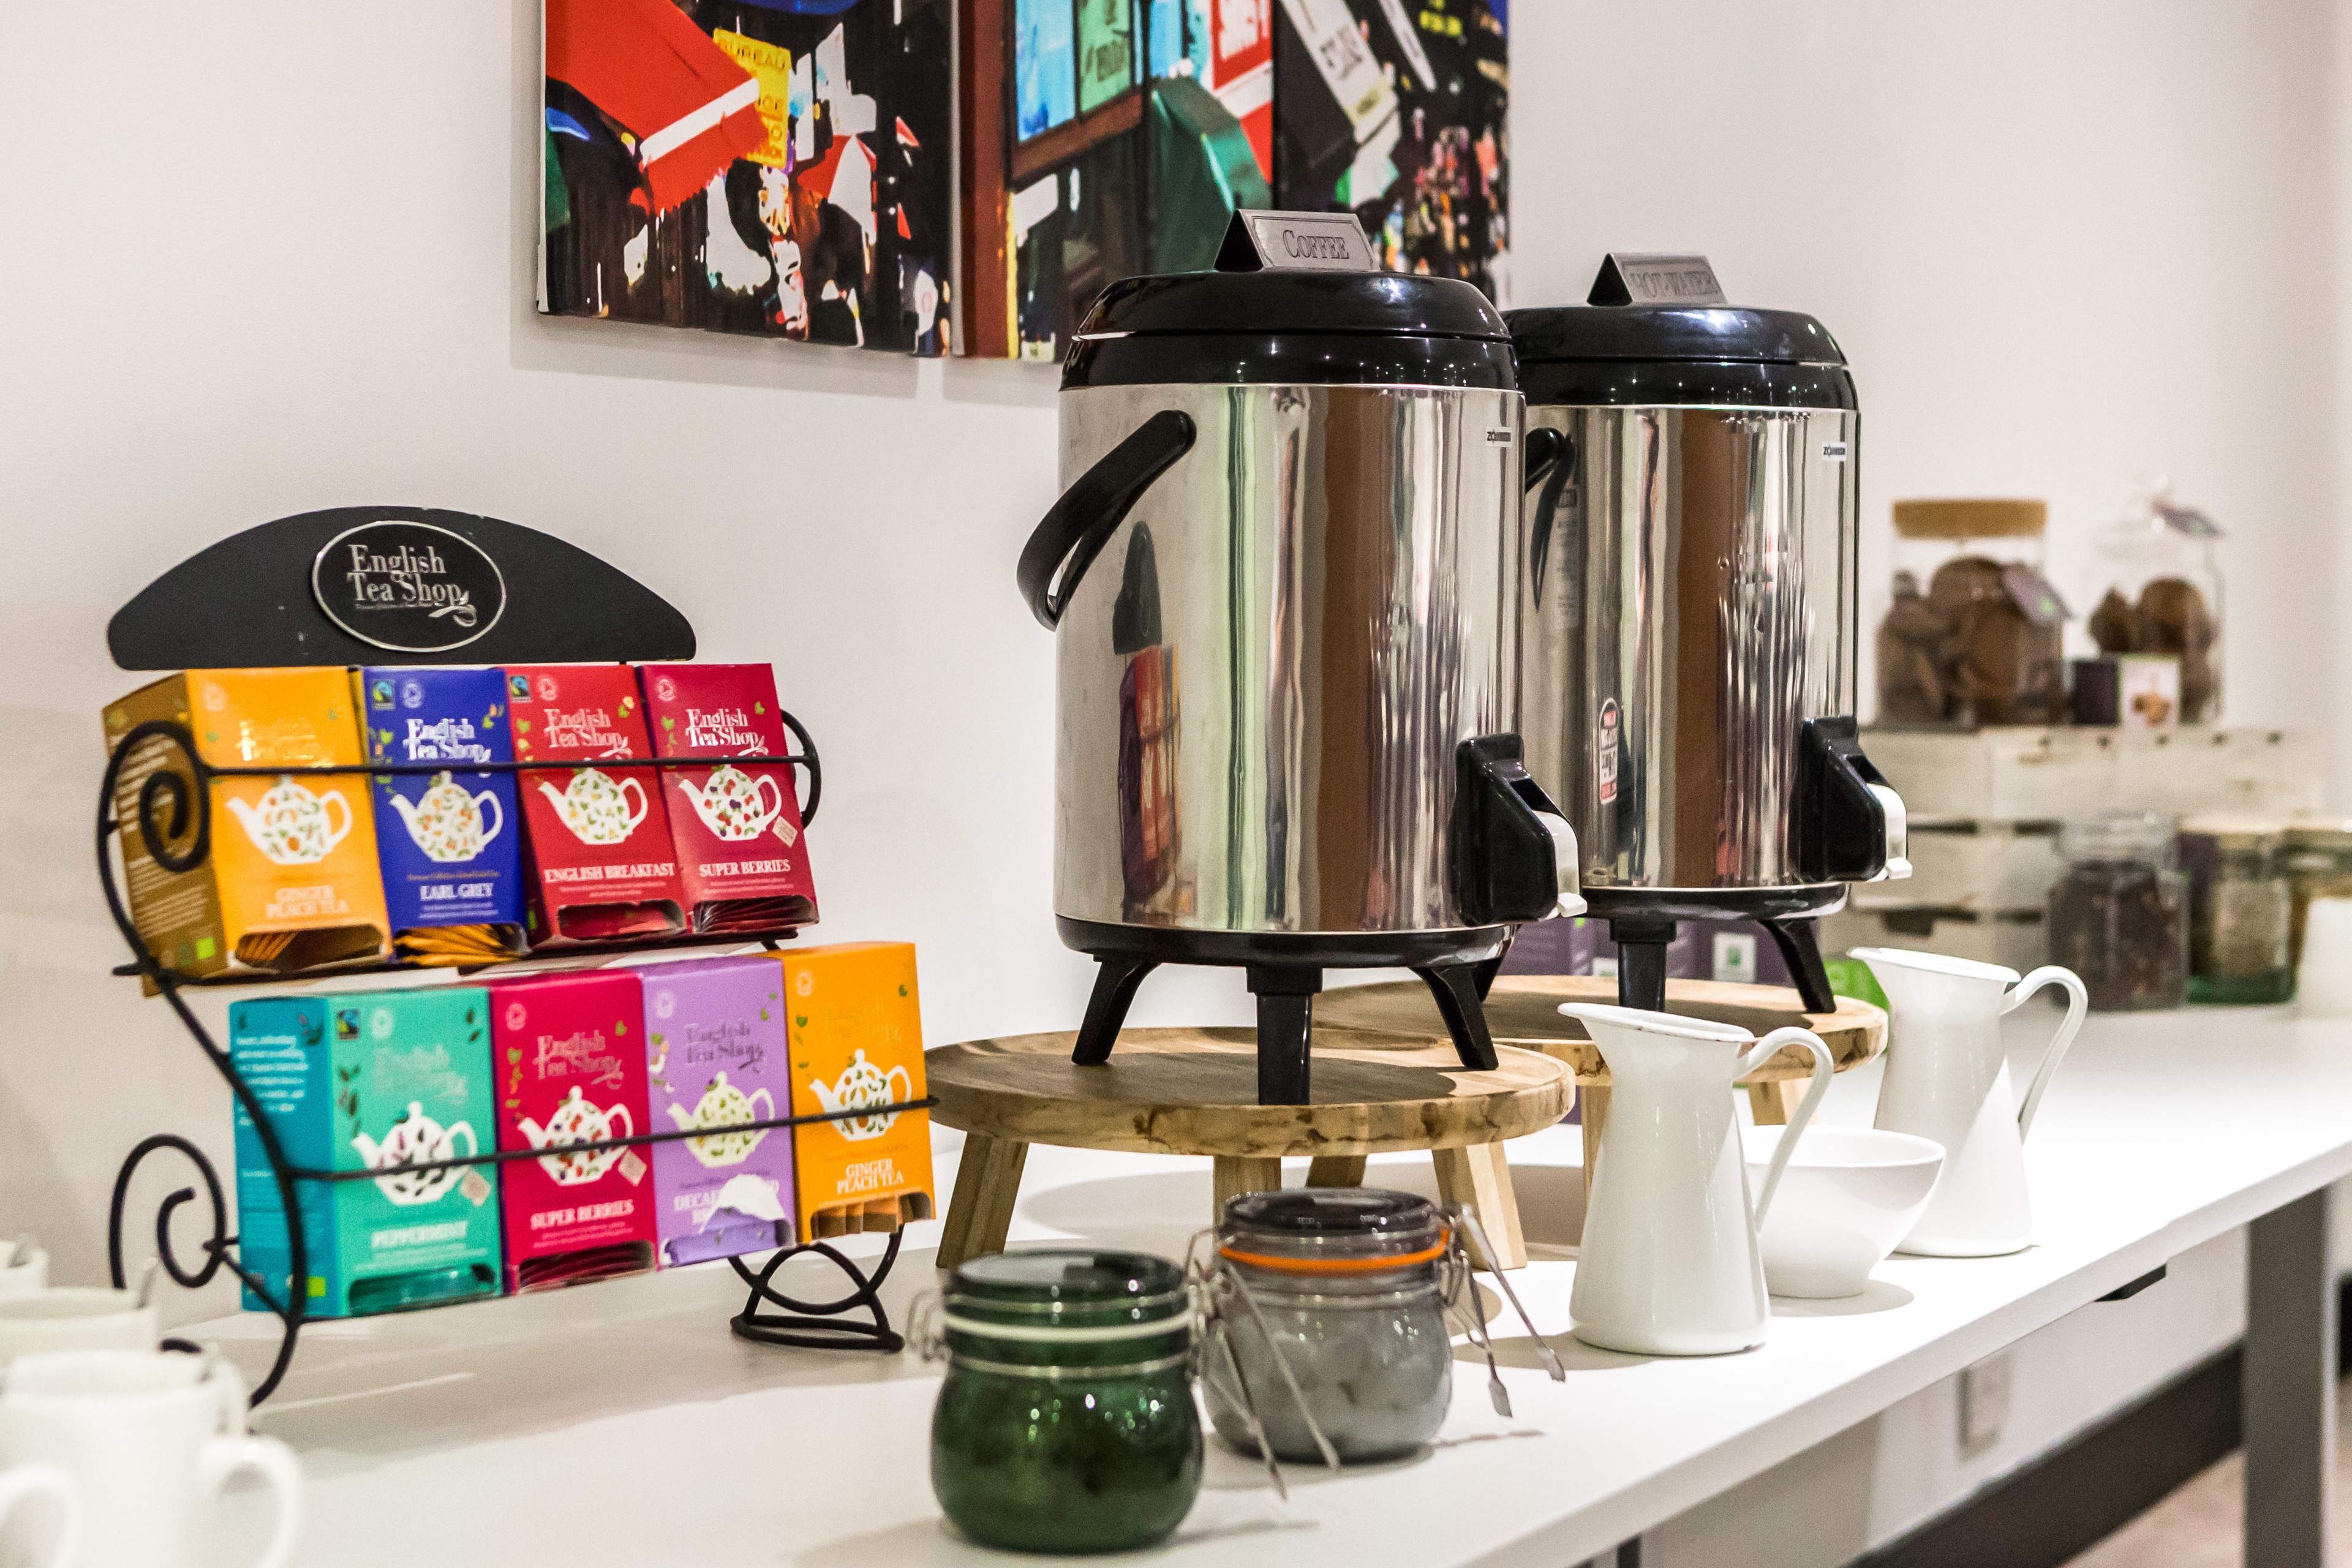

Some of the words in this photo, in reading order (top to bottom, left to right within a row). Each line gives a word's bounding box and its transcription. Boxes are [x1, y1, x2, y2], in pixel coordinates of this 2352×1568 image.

[1283, 230, 1349, 259] COFFEE
[347, 544, 447, 573] English
[346, 571, 394, 601] Tea
[391, 570, 464, 609] Shop
[407, 718, 475, 739] English
[544, 709, 612, 728] English
[685, 708, 749, 728] English
[544, 725, 579, 748] Tea
[573, 725, 628, 750] Shop
[685, 726, 719, 747] Tea
[713, 725, 765, 750] Shop
[544, 867, 603, 883] ENGLISH
[605, 862, 675, 879] BREAKFAST
[699, 862, 740, 877] SUPER
[741, 859, 791, 874] BERRIES
[420, 884, 458, 901] EARL
[846, 1158, 894, 1178] GINGER
[837, 1174, 879, 1194] PEACH
[878, 1170, 904, 1188] TEA
